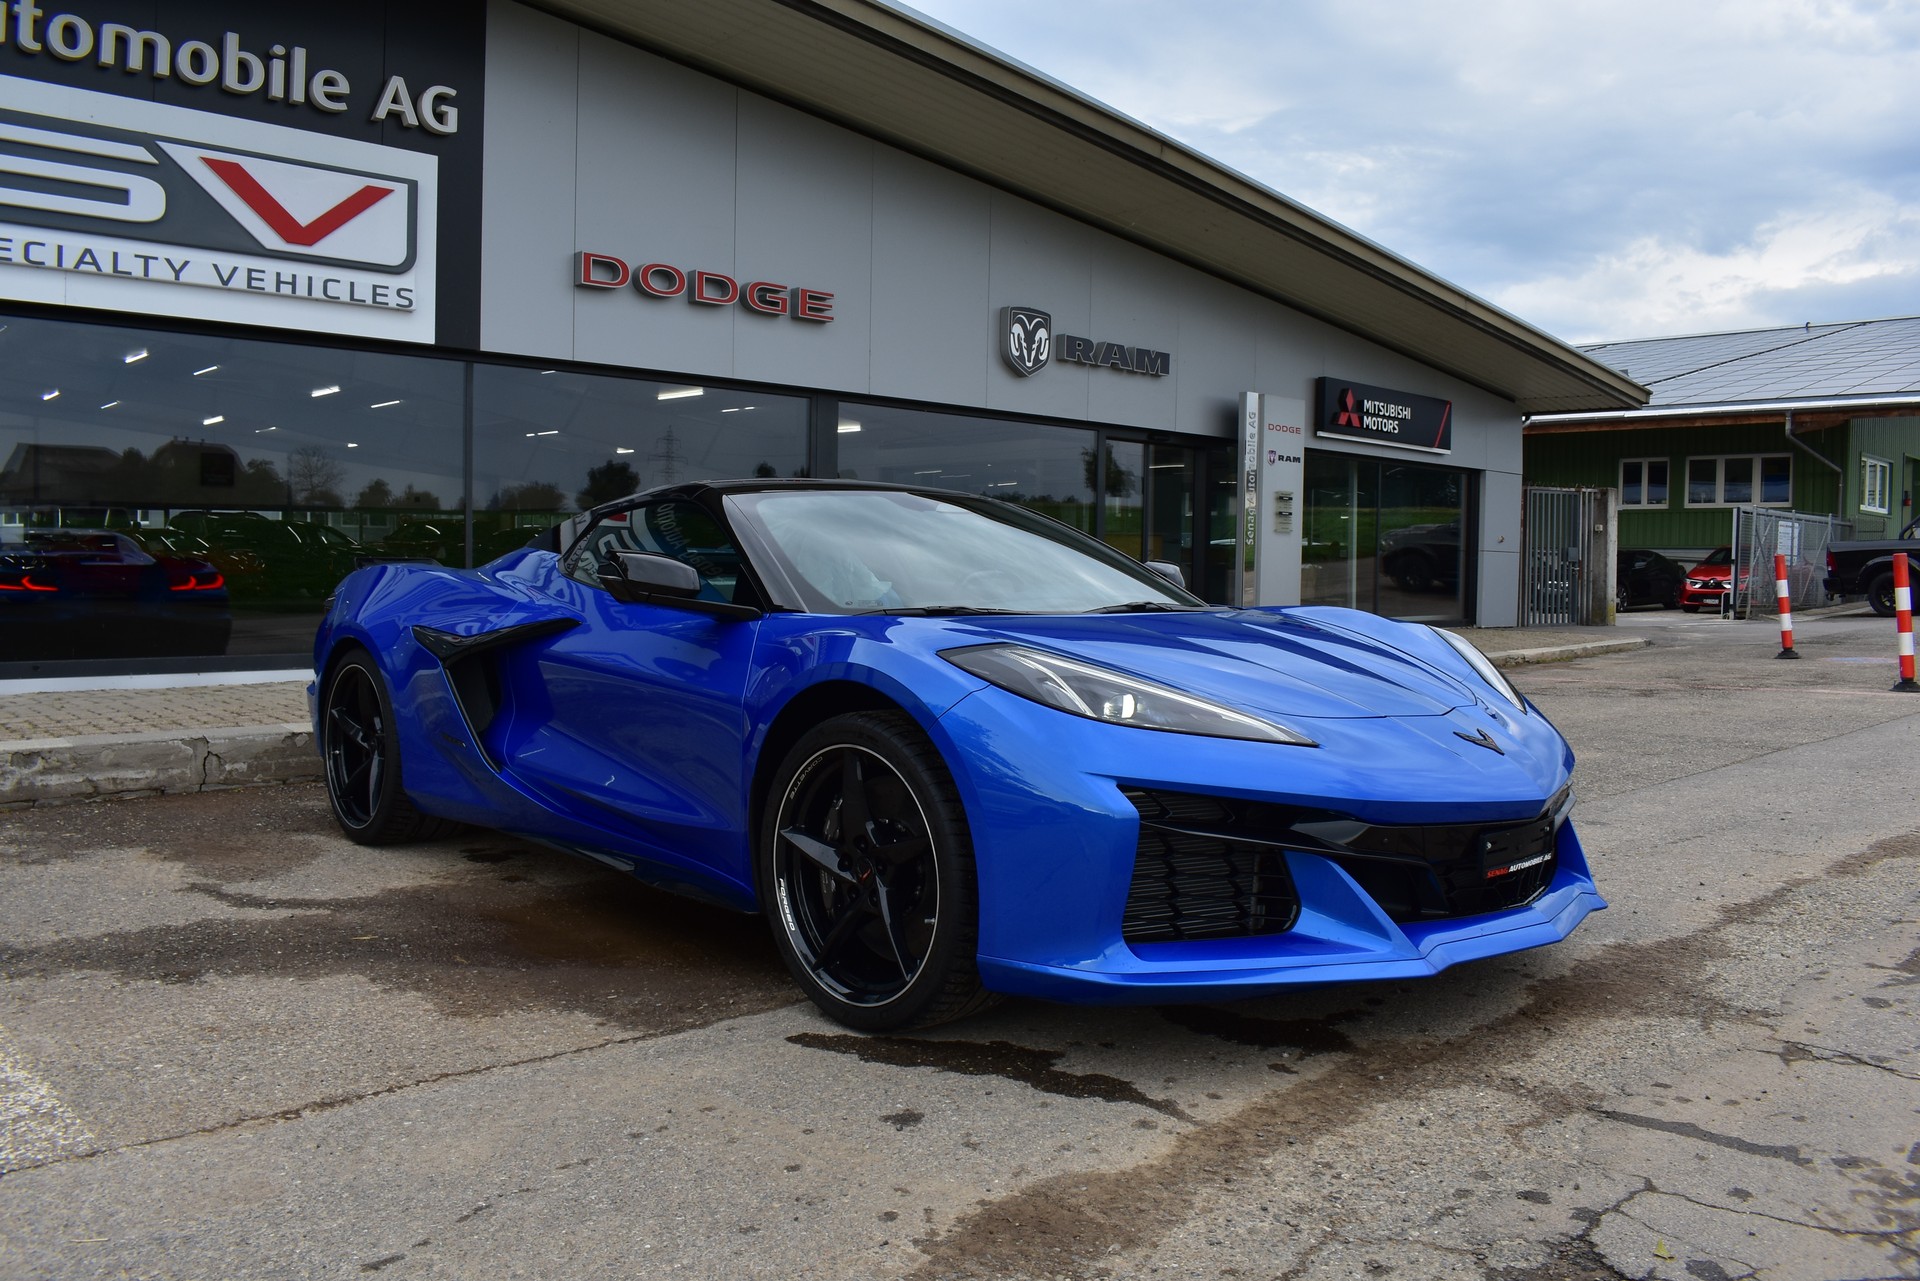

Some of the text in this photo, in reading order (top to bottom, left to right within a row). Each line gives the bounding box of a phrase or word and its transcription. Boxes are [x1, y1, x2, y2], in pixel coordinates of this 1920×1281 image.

[371, 75, 458, 135] AG
[212, 263, 414, 309] VEHICLES
[575, 250, 834, 323] DODGE
[1057, 334, 1170, 376] RAM
[1248, 411, 1256, 429] AG
[1268, 423, 1301, 434] DODGE
[1363, 399, 1411, 420] MITSUBISHI
[1363, 415, 1399, 434] MOTORS
[1277, 454, 1301, 464] RAM
[1246, 508, 1257, 546] Senag
[789, 756, 823, 800] CORVETTE
[1487, 867, 1508, 878] SENAG
[1543, 852, 1551, 861] AG
[779, 877, 796, 931] FORGED
